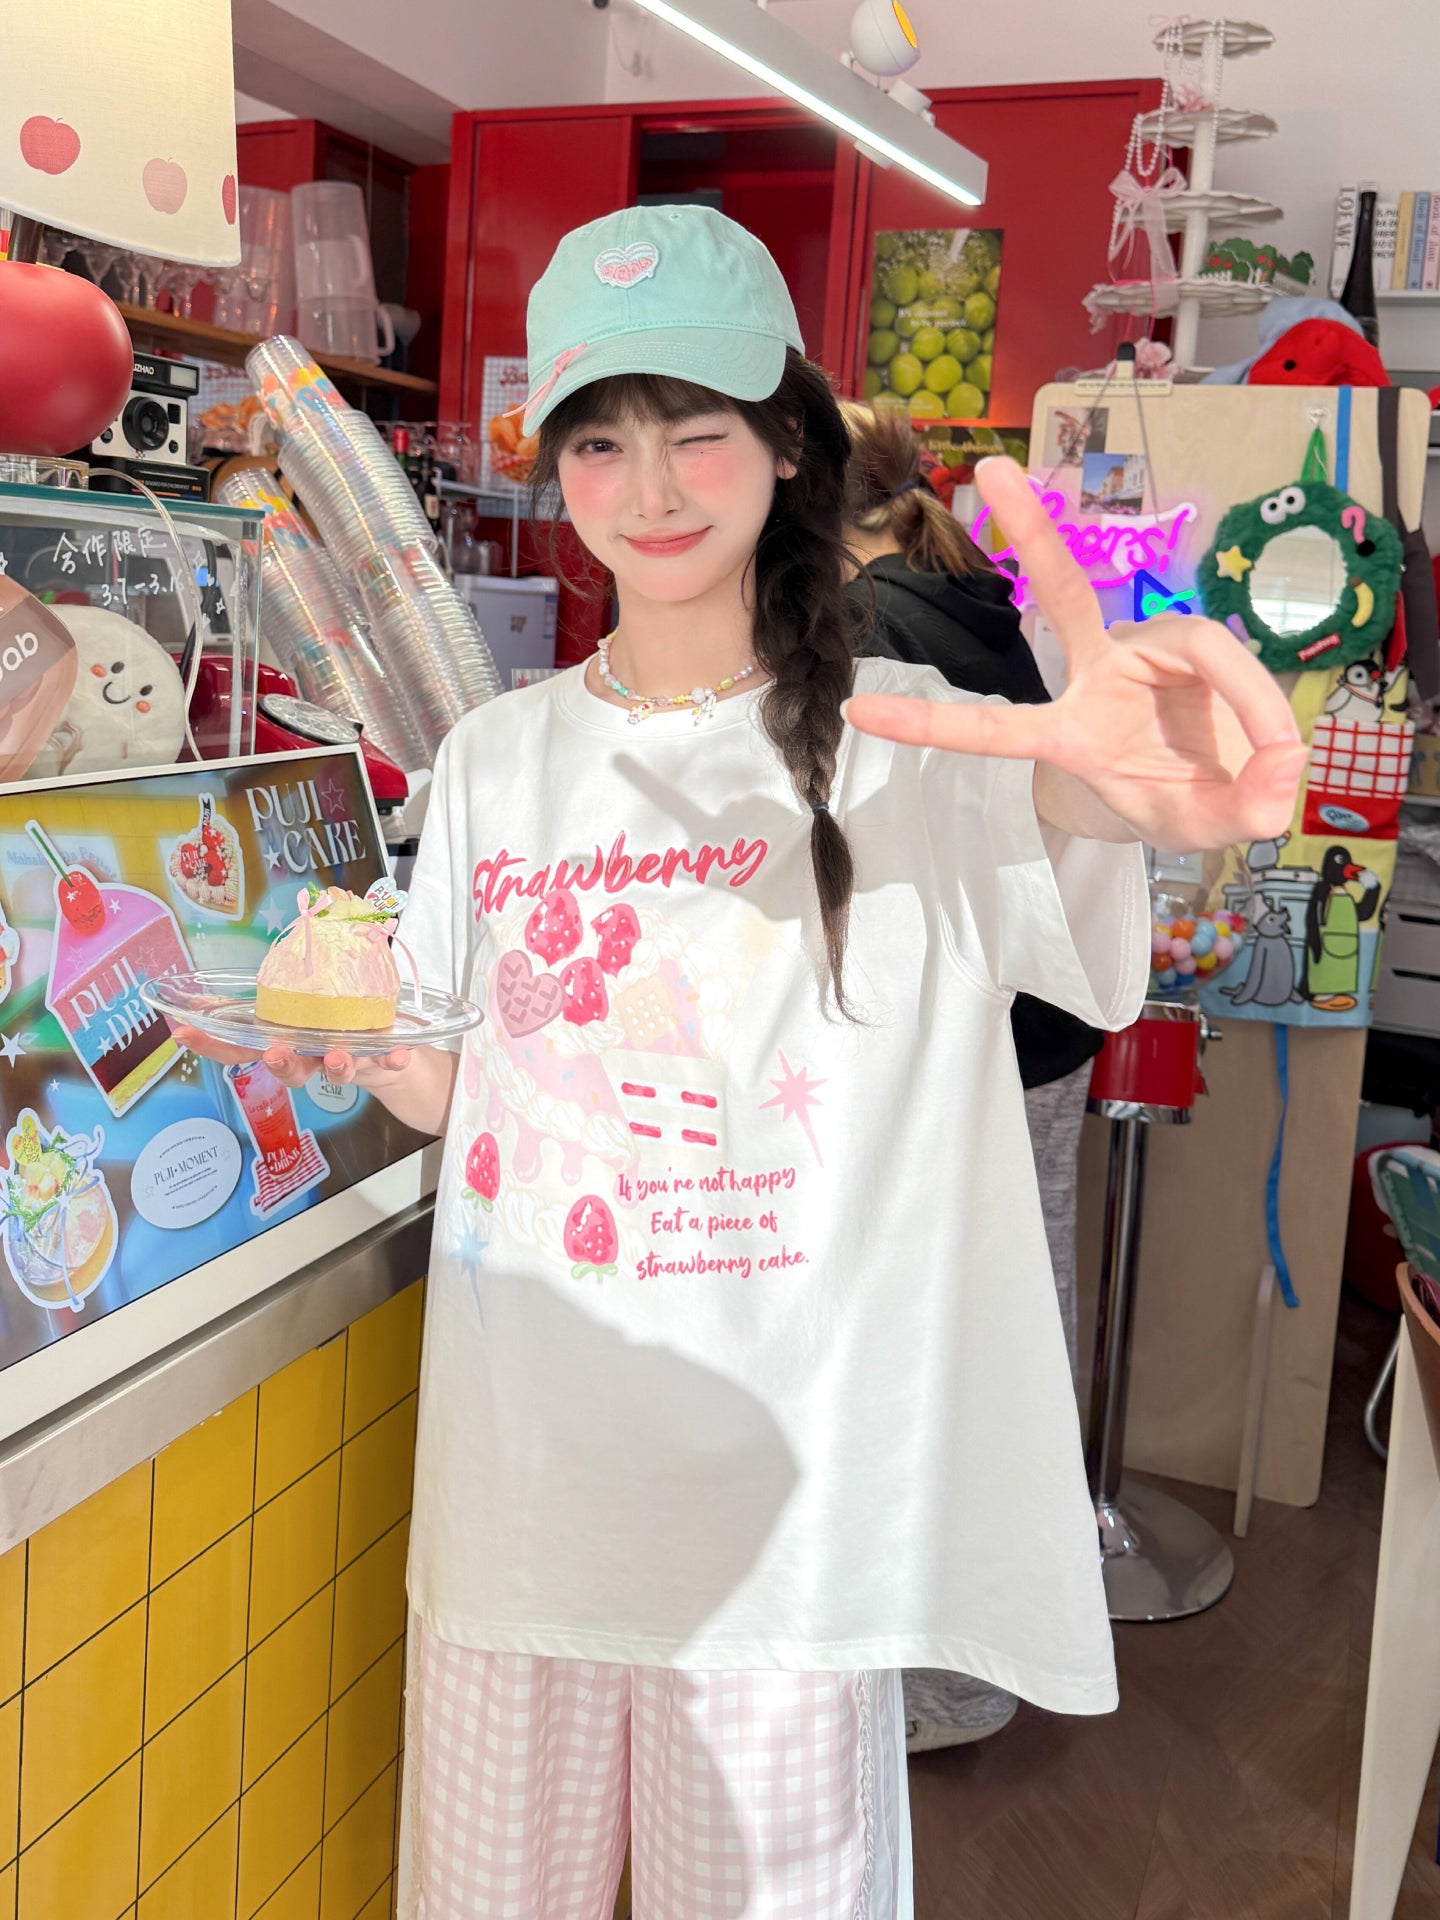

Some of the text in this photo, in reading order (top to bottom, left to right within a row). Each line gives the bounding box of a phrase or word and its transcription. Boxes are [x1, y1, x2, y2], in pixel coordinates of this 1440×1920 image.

[53, 524, 167, 574] 合作限定
[0, 632, 38, 683] ab
[244, 780, 324, 832] PUJI
[283, 819, 366, 873] CAKE
[70, 956, 141, 1032] PUJI
[637, 1166, 695, 1201] you're
[651, 1206, 690, 1235] Eat
[688, 1216, 703, 1231] a
[707, 1212, 754, 1239] piece
[636, 1244, 810, 1281] strawberry cake.
